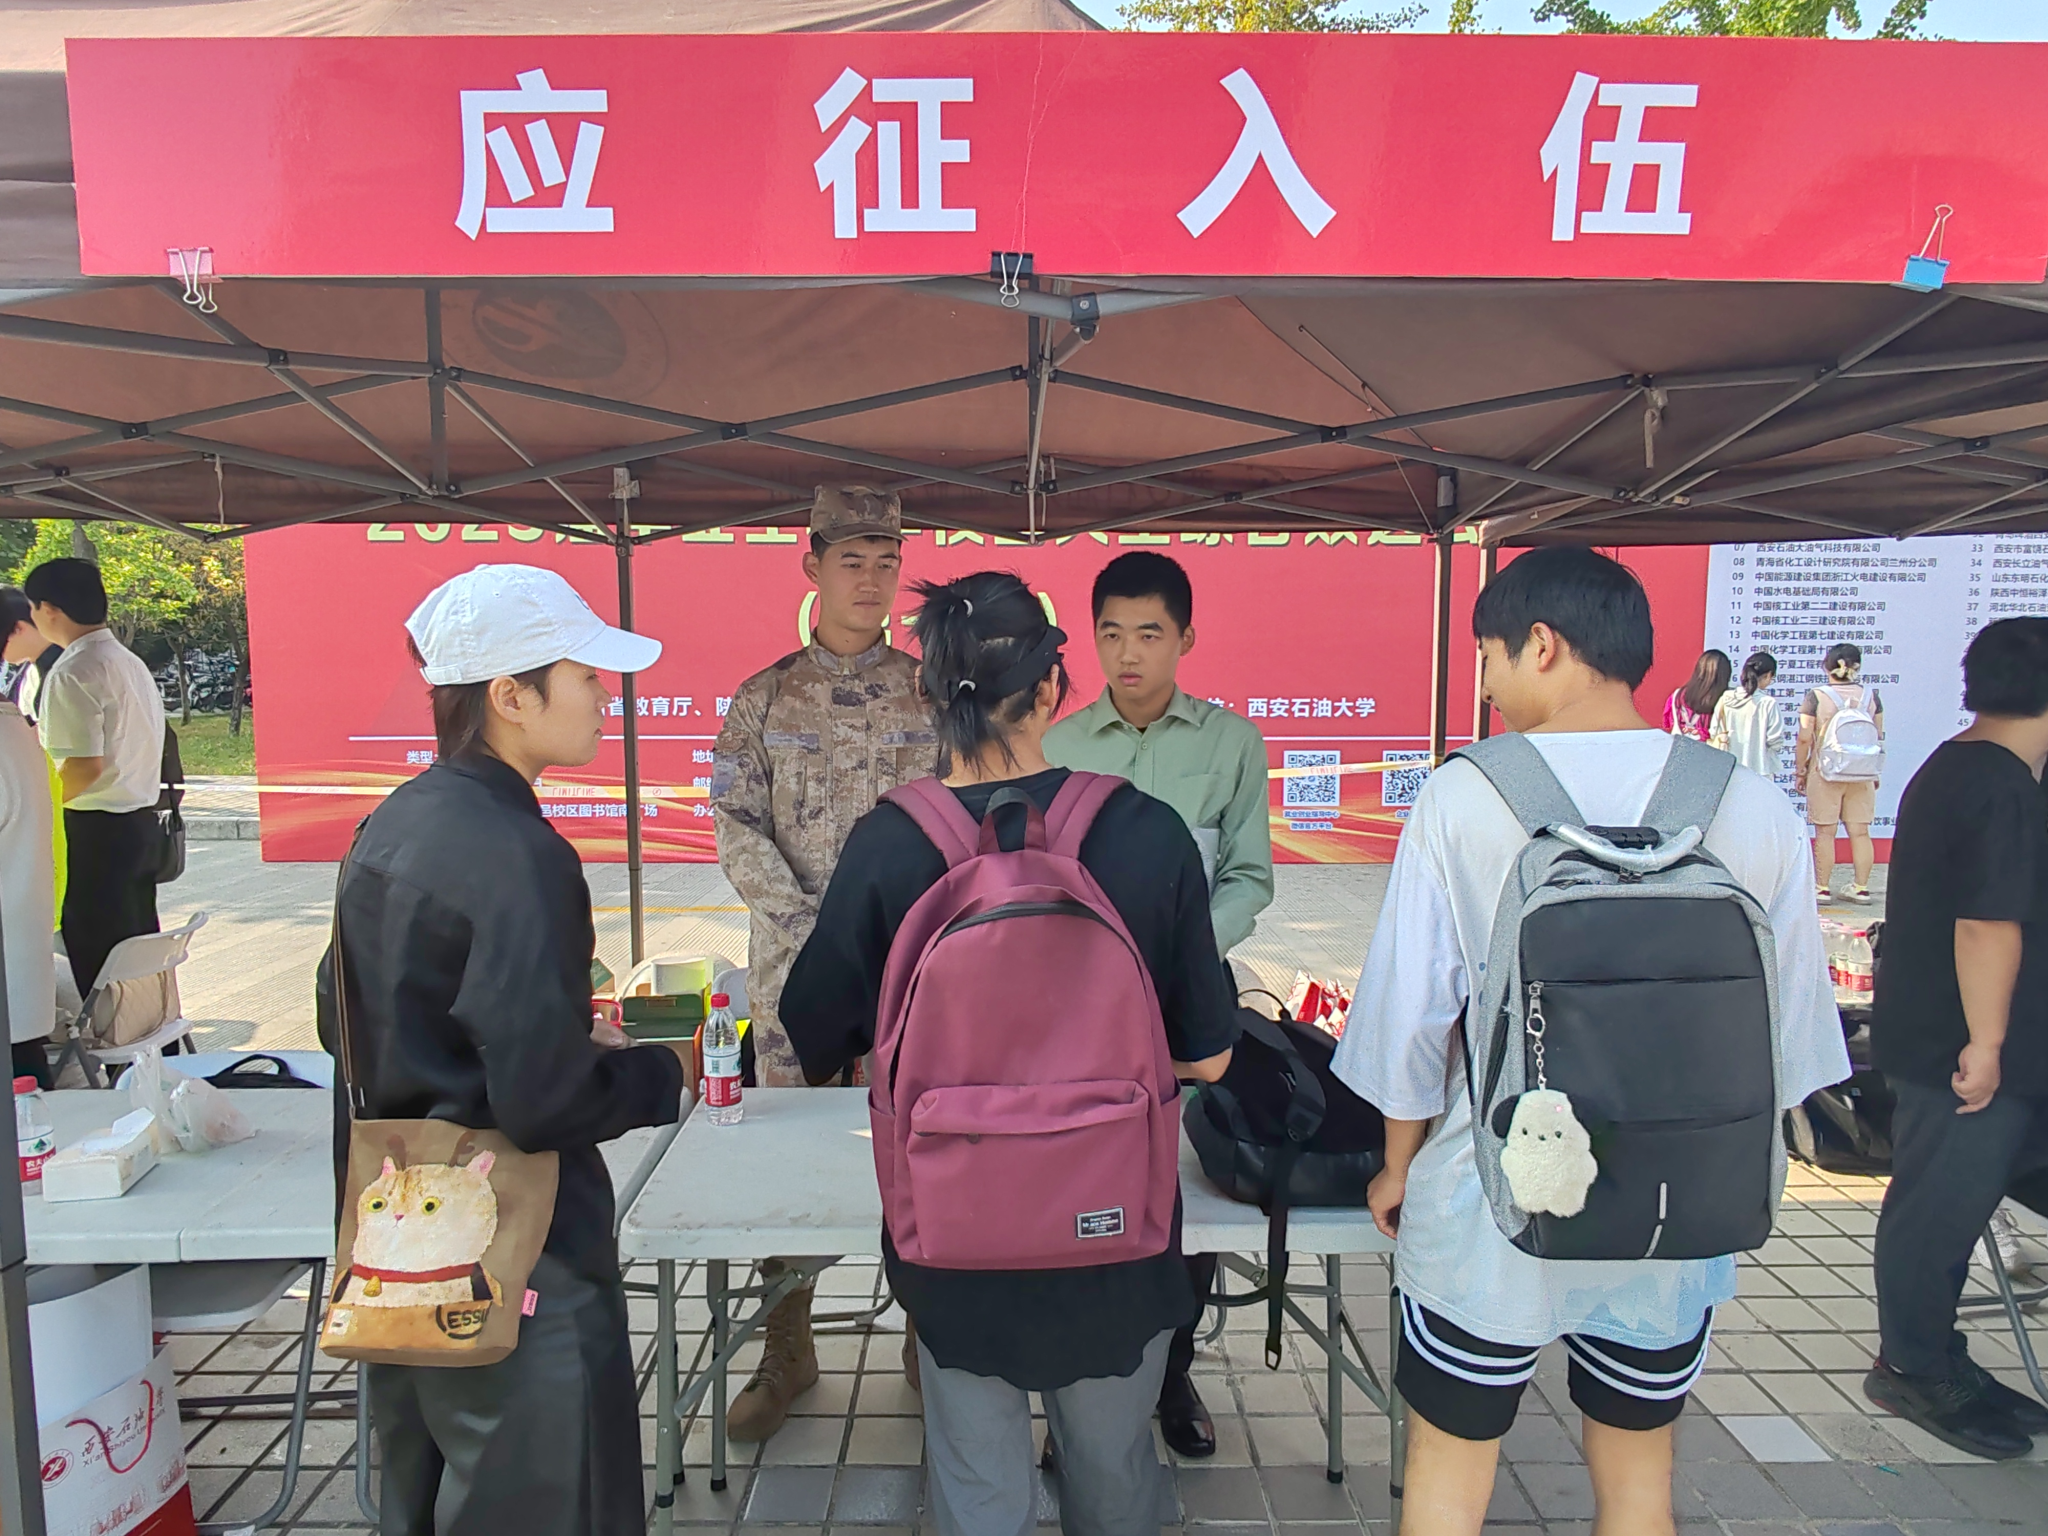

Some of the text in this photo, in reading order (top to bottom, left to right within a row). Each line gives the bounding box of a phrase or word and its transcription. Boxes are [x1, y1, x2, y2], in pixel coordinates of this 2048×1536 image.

[455, 65, 1699, 242] 应征入伍
[1971, 544, 1983, 552] 33
[1732, 557, 1937, 568] 08 青海省化工设计研究院有限公司兰州分公司
[1970, 558, 1982, 567] 34
[1732, 572, 1927, 582] 09 中国能源建设集团浙江火电建设有限公司
[1969, 573, 1981, 582] 35
[1731, 586, 1859, 597] 10 中国水电基础局有限公司
[1968, 588, 1980, 596] 36
[1730, 601, 1887, 611] 11 中国核工业第二二建设有限公司
[1966, 602, 2048, 612] 37 河北华北石油
[1729, 616, 1876, 626] 12 中国核工业二三建设有限公司
[1965, 617, 1977, 625] 38
[1729, 630, 1884, 640] 13 中国化学工程第七建设有限公司
[1728, 645, 1740, 653] 14
[1957, 718, 1969, 727] 45
